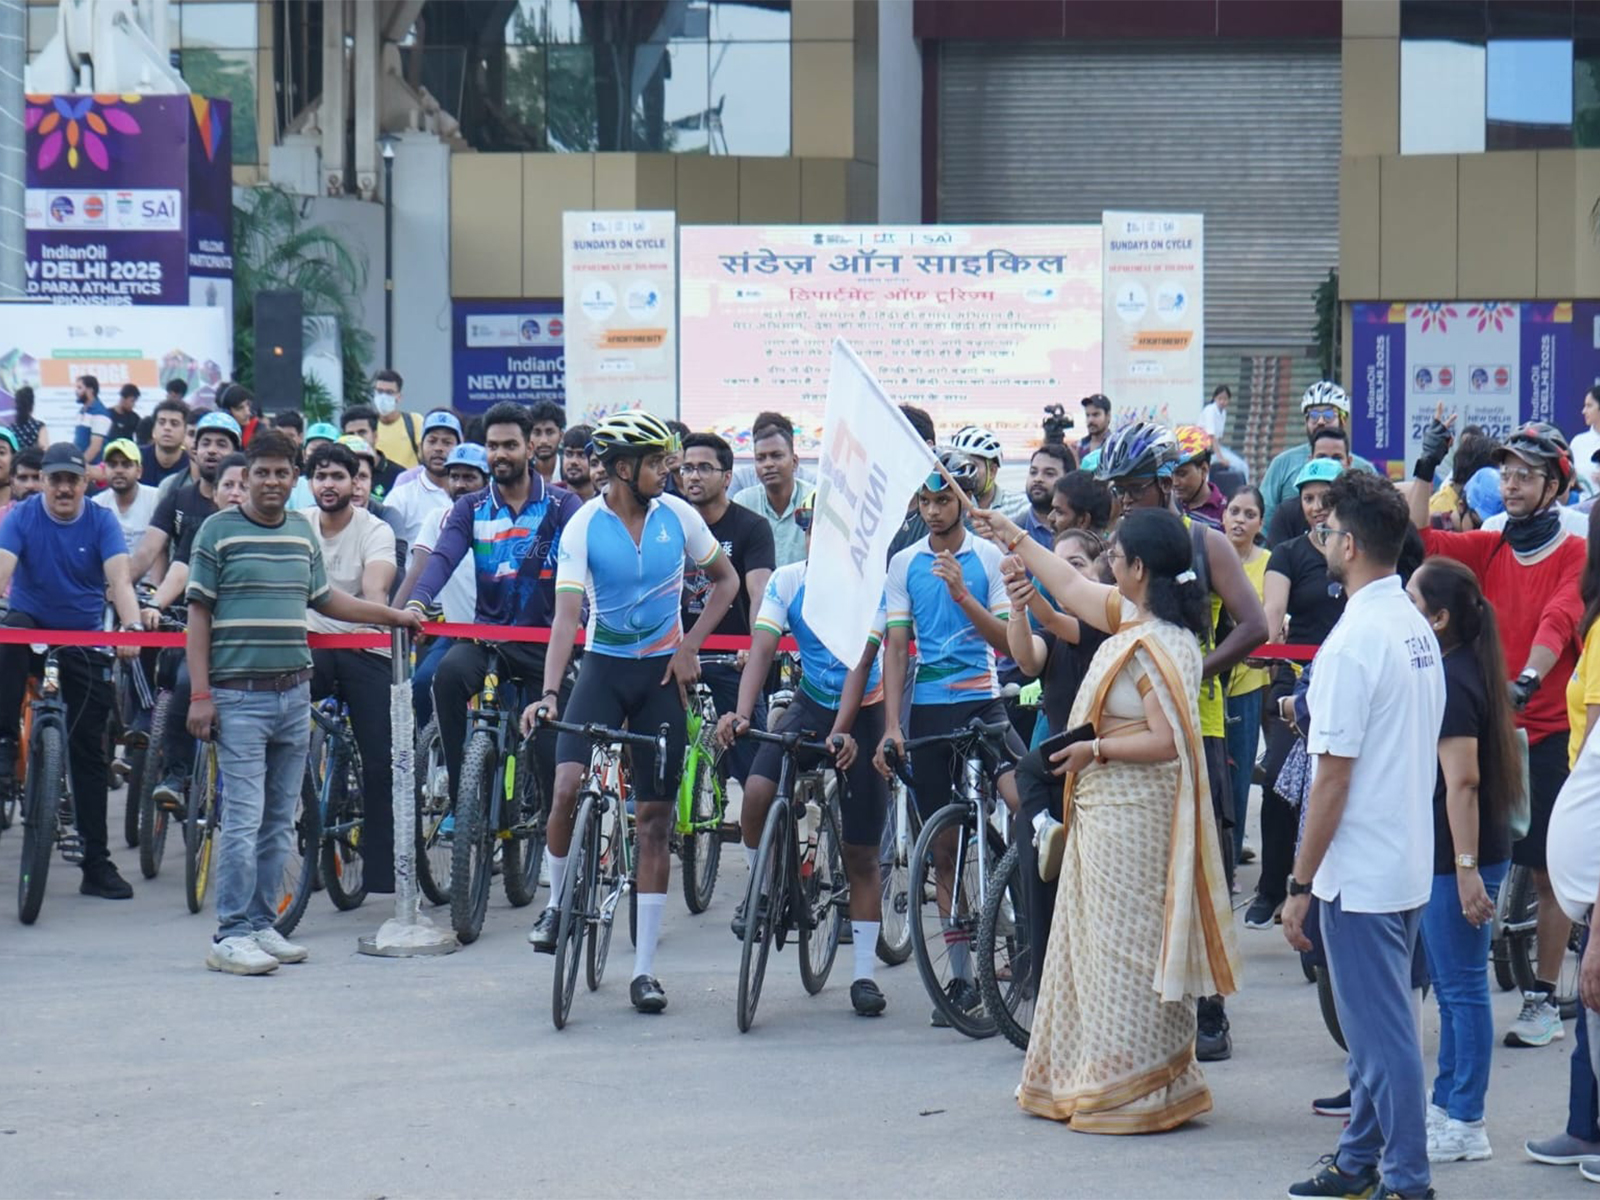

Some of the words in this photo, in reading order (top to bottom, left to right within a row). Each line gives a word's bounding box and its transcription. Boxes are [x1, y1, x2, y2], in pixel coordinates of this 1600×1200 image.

[142, 200, 175, 218] SAI
[41, 244, 107, 260] IndianOil
[573, 240, 617, 250] SUNDAYS
[620, 240, 633, 249] ON
[636, 238, 666, 249] CYCLE
[1110, 240, 1149, 250] SUNDAYS
[1151, 240, 1164, 249] ON
[1166, 239, 1193, 249] CYCLE
[41, 262, 107, 279] DELHI
[110, 262, 163, 280] 2025
[827, 248, 905, 275] ऑन
[912, 248, 1069, 278] साइकिल
[41, 282, 79, 295] PARA
[82, 282, 162, 295] ATHLETICS
[1375, 335, 1385, 368] 2025
[1541, 335, 1550, 368] 2025
[467, 374, 513, 390] NEW
[516, 374, 565, 389] DELH
[1366, 365, 1376, 419] IndianOil
[1375, 370, 1385, 412] DELHI
[1531, 365, 1540, 420] IndianOil
[1541, 370, 1550, 414] DELHI
[1375, 414, 1385, 449] NEW
[1481, 424, 1511, 440] 025
[1404, 635, 1431, 657] TEAM
